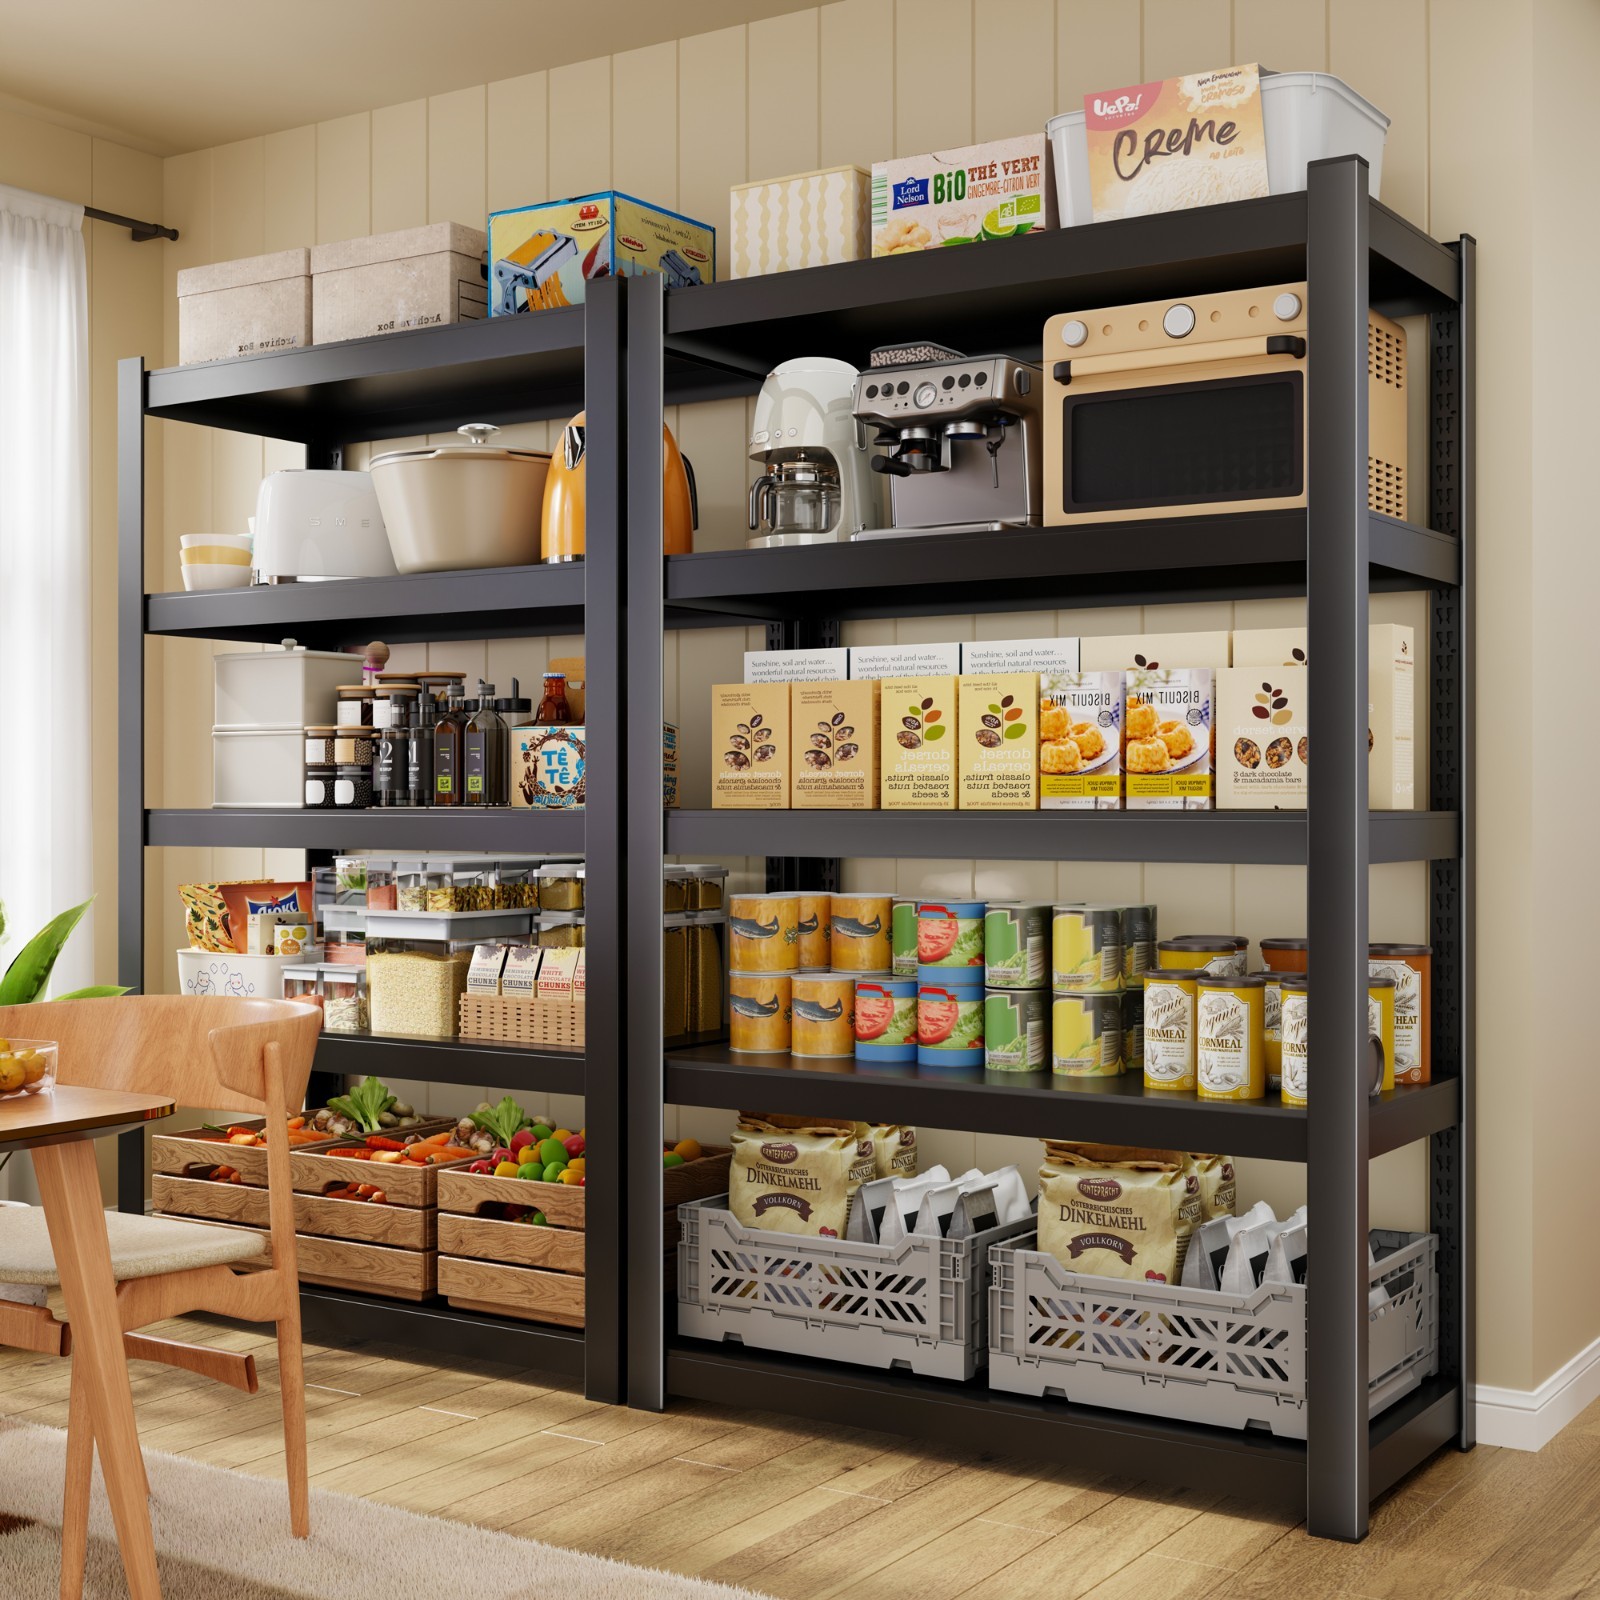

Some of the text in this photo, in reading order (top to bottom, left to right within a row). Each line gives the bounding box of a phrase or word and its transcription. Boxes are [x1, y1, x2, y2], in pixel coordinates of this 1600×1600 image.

[968, 156, 1040, 182] THÉ VERT
[1026, 173, 1040, 188] VERT
[901, 184, 920, 195] Lord
[897, 194, 925, 205] Nelson
[858, 656, 889, 664] Sunshine,
[971, 651, 1004, 659] Sunshine,
[752, 660, 781, 668] Sunshine,
[782, 659, 794, 667] soil
[794, 658, 807, 666] and
[971, 660, 1006, 668] wonderful
[1233, 726, 1307, 736] dorset cere
[380, 742, 393, 764] 2
[542, 748, 568, 766] TÊ
[545, 768, 570, 784] TÊ
[468, 977, 497, 985] CHUNKS
[503, 979, 533, 987] CHUNKS
[1394, 1016, 1418, 1025] HEAT
[1146, 1028, 1187, 1039] CORNMEAL
[1199, 1037, 1243, 1049] CORNMEAL
[747, 1168, 822, 1191] DINKELMEHL
[764, 1196, 803, 1209] VOLLKORN
[1071, 1199, 1133, 1215] ÖSTERREICHISCHES
[1059, 1204, 1147, 1231] DINKELMEHL
[1080, 1237, 1124, 1250] VOLLKORN
